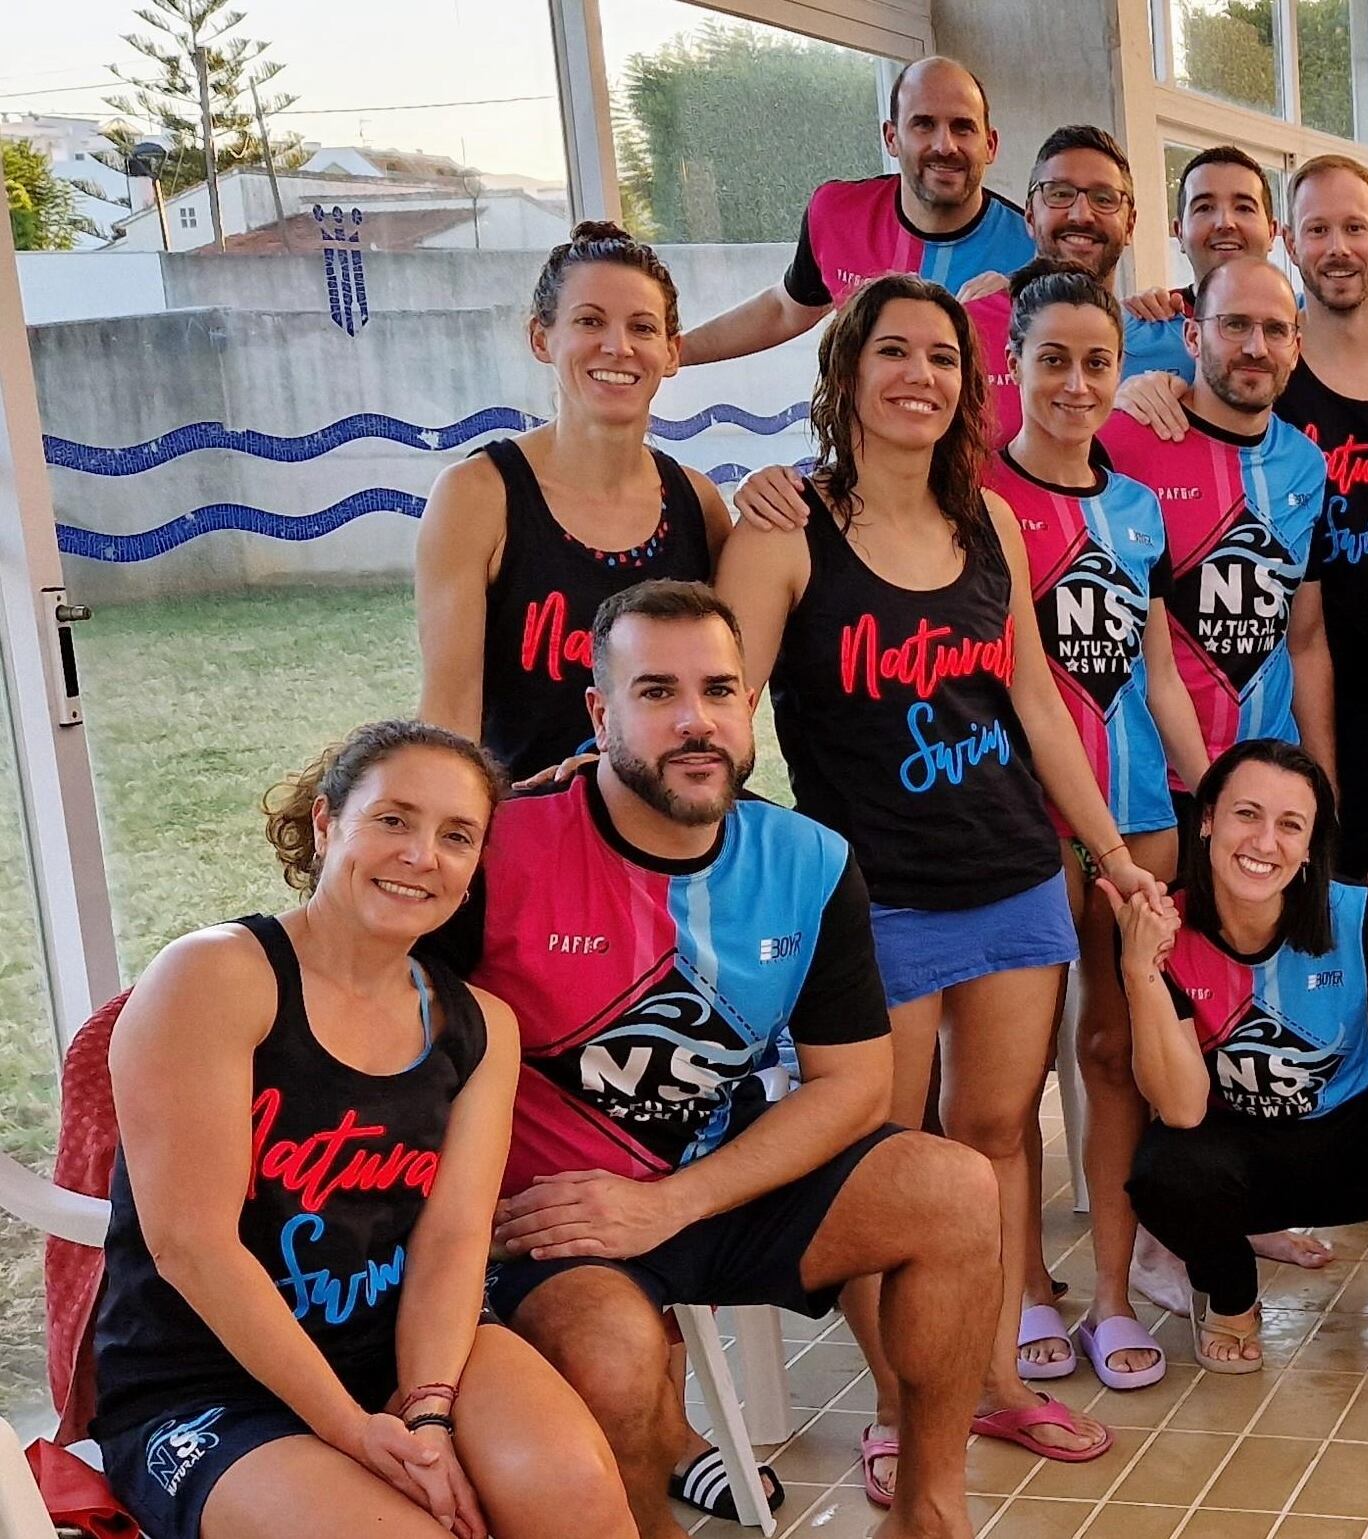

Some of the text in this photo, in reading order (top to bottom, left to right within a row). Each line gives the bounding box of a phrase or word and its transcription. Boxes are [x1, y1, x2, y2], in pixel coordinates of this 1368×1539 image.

[1056, 584, 1135, 641] NS
[1199, 558, 1285, 618] NS
[1059, 640, 1126, 657] NATURA
[1199, 619, 1276, 637] NATURAL
[1220, 635, 1275, 655] SWIM
[841, 614, 1016, 699] Natural
[900, 702, 1010, 793] Swim
[580, 1040, 725, 1102] NS
[1217, 1047, 1310, 1097] NS
[1246, 1102, 1313, 1118] SWIM
